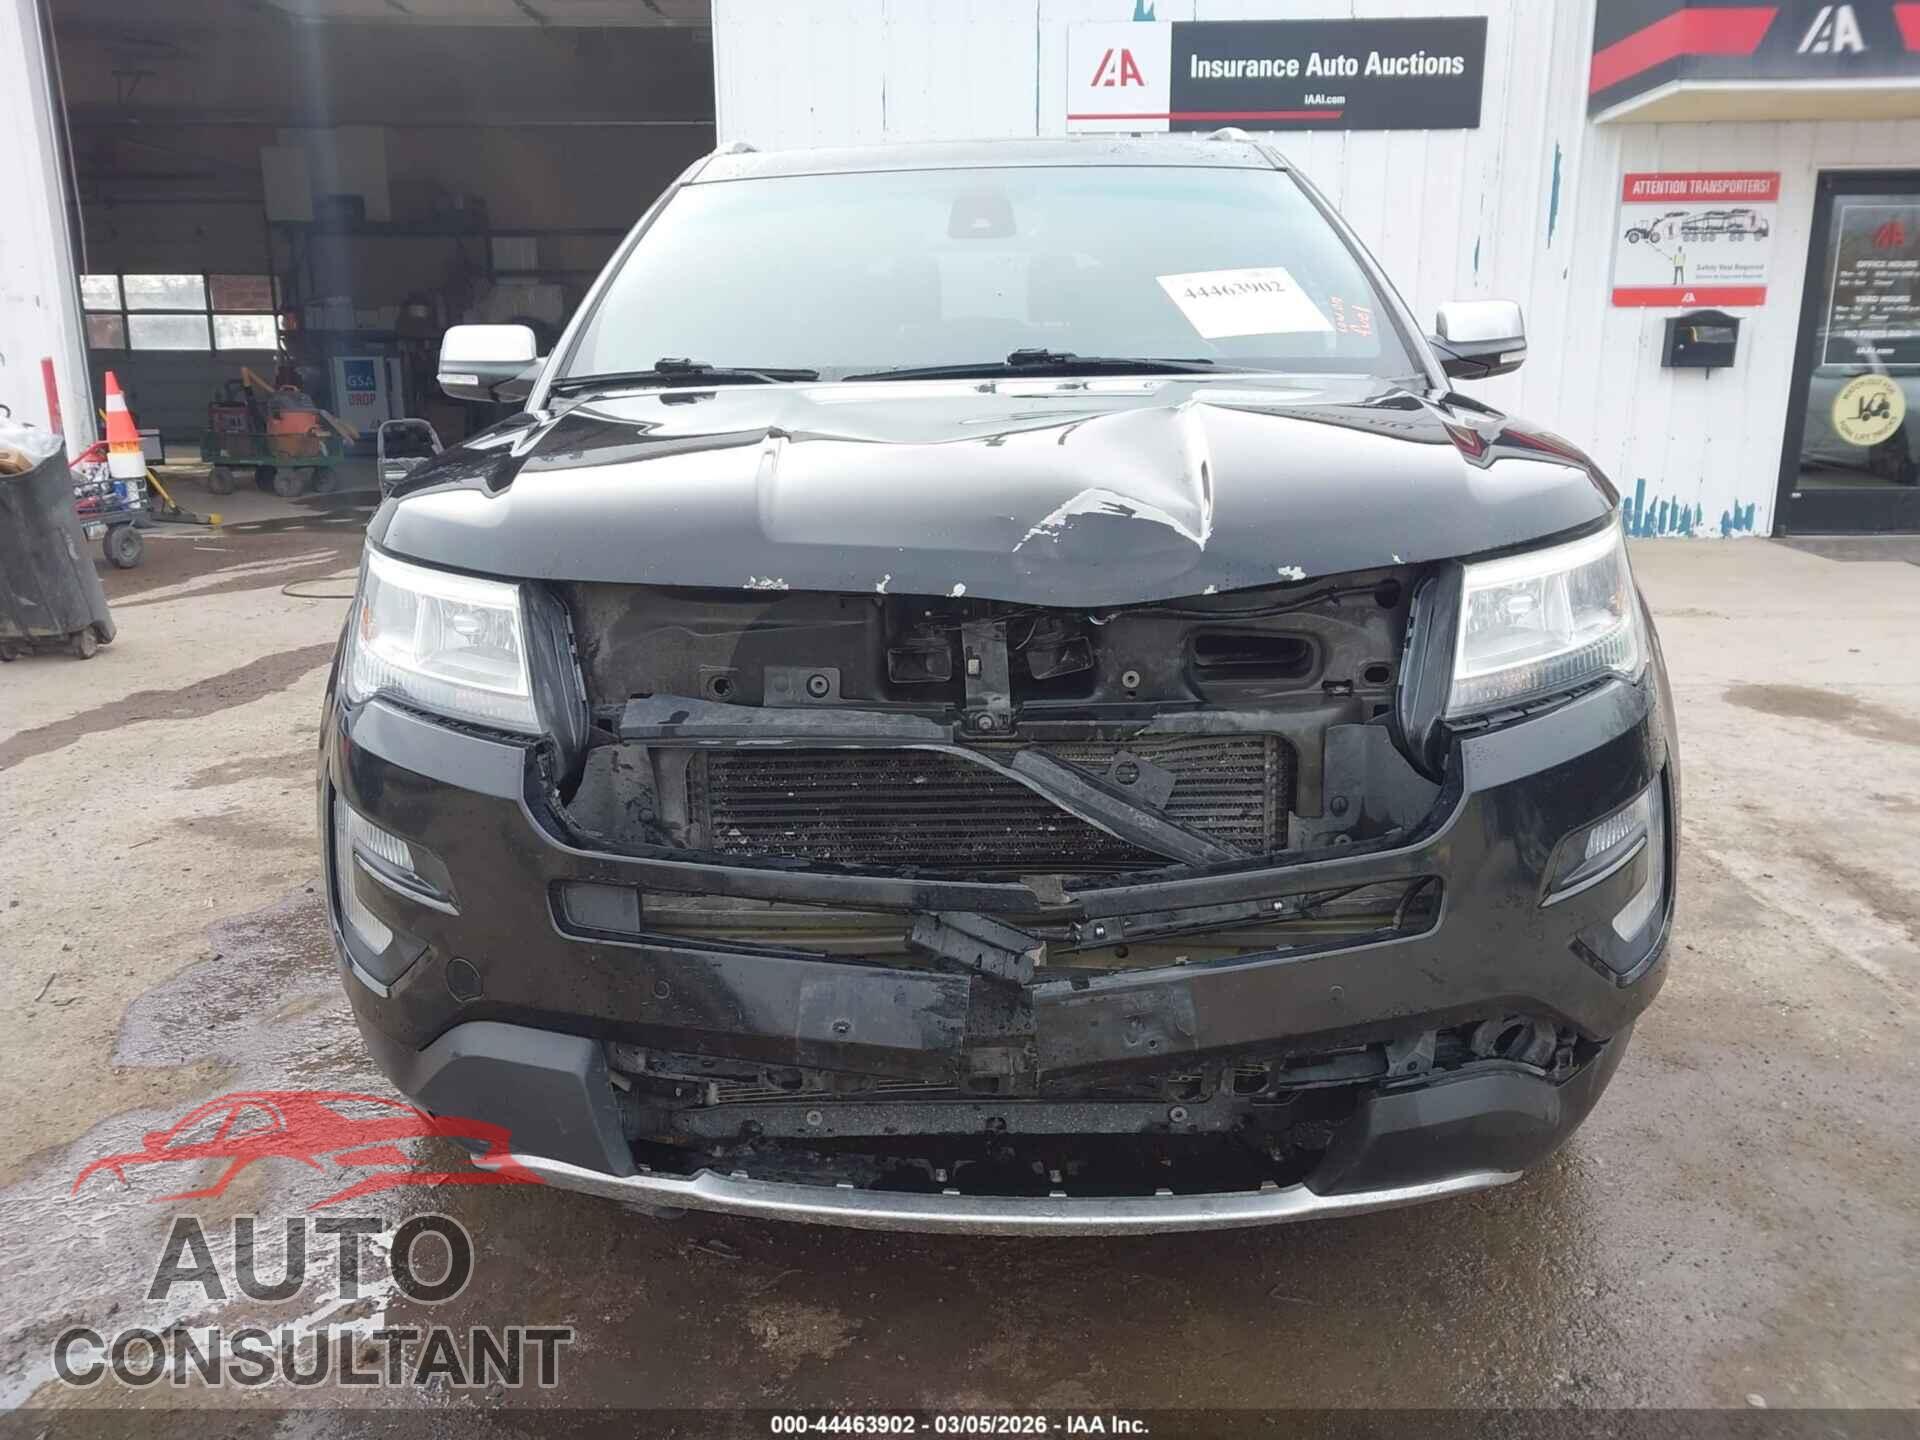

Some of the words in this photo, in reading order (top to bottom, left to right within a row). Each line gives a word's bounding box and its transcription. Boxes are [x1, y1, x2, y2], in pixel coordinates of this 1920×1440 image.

[1190, 54, 1300, 80] Insurance
[1305, 52, 1359, 77] Auto
[1364, 50, 1465, 77] Auctions
[1632, 180, 1687, 195] ATTENTION
[1690, 179, 1770, 194] TRANSPORTERS!
[1183, 280, 1287, 300] 44463902
